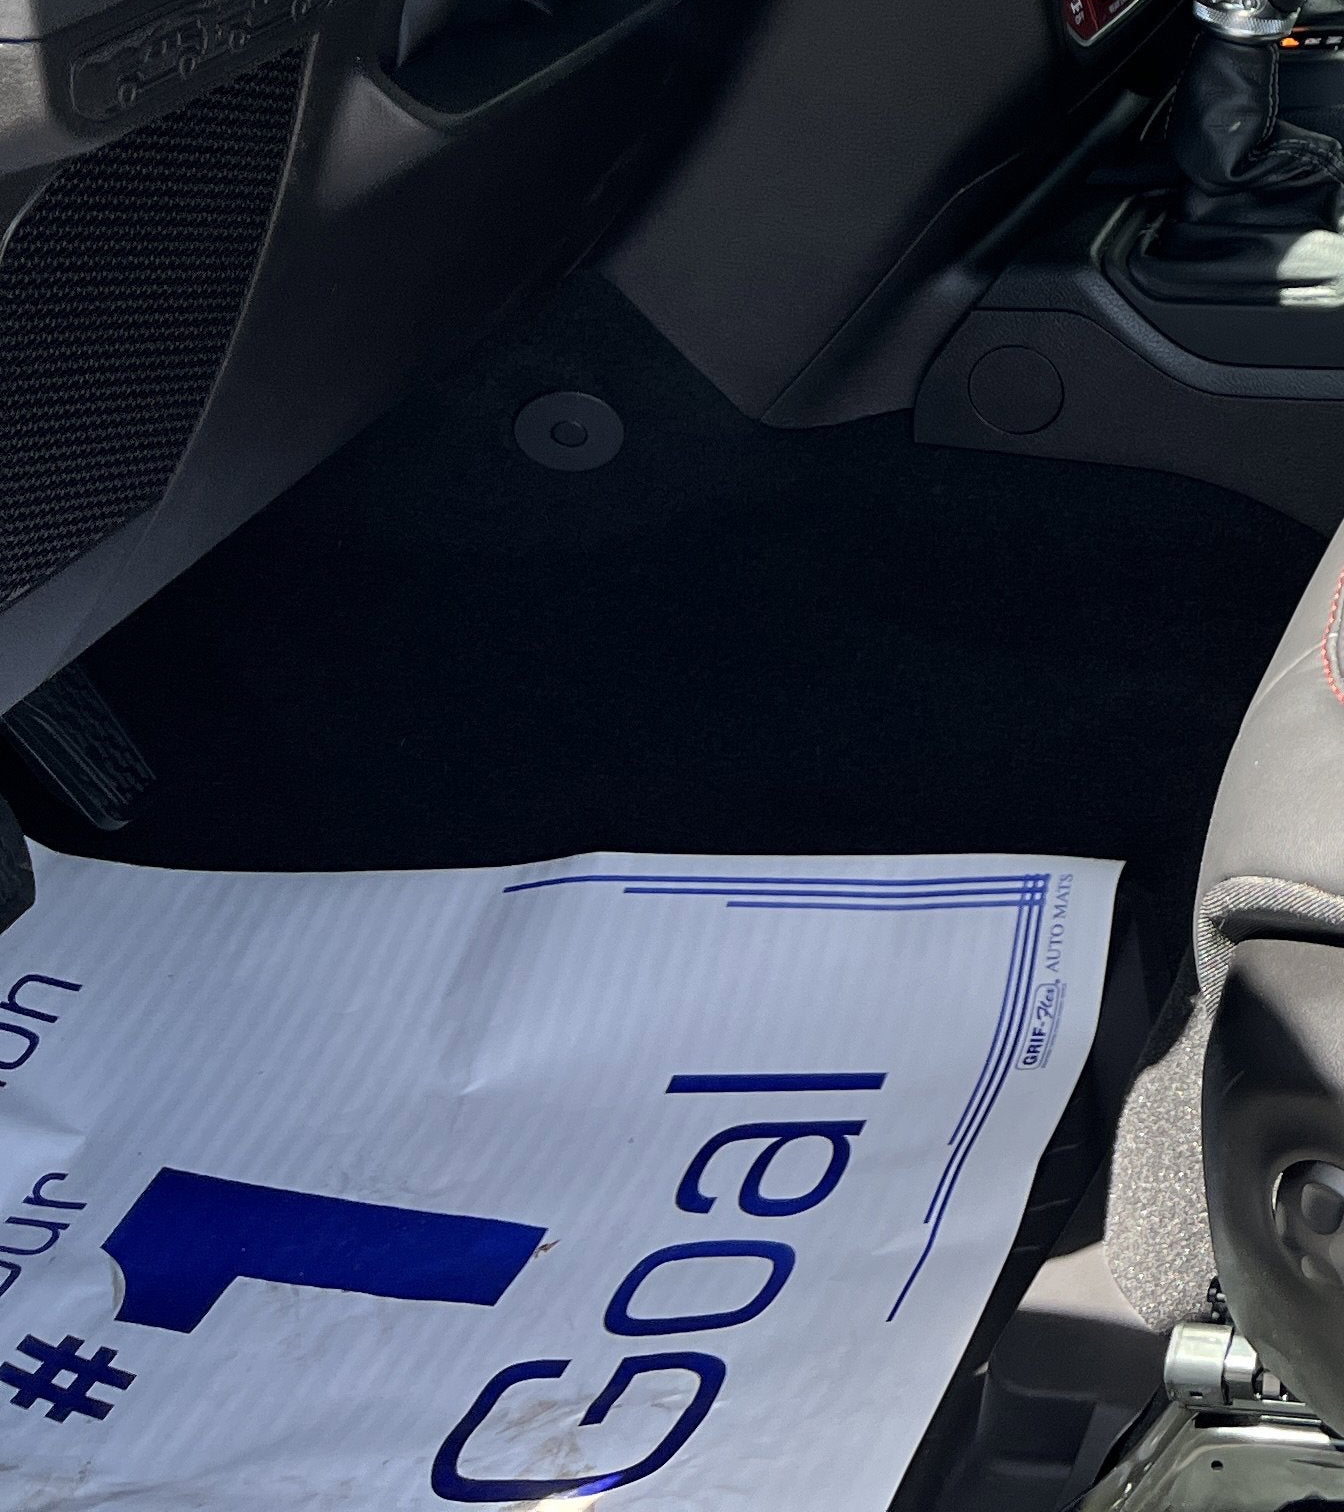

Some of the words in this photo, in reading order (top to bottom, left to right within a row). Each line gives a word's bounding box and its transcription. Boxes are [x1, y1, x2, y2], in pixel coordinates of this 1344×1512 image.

[1046, 924, 1065, 973] AUTO
[1053, 873, 1074, 919] MATS
[0, 1166, 548, 1423] #1
[431, 1070, 889, 1503] Goal
